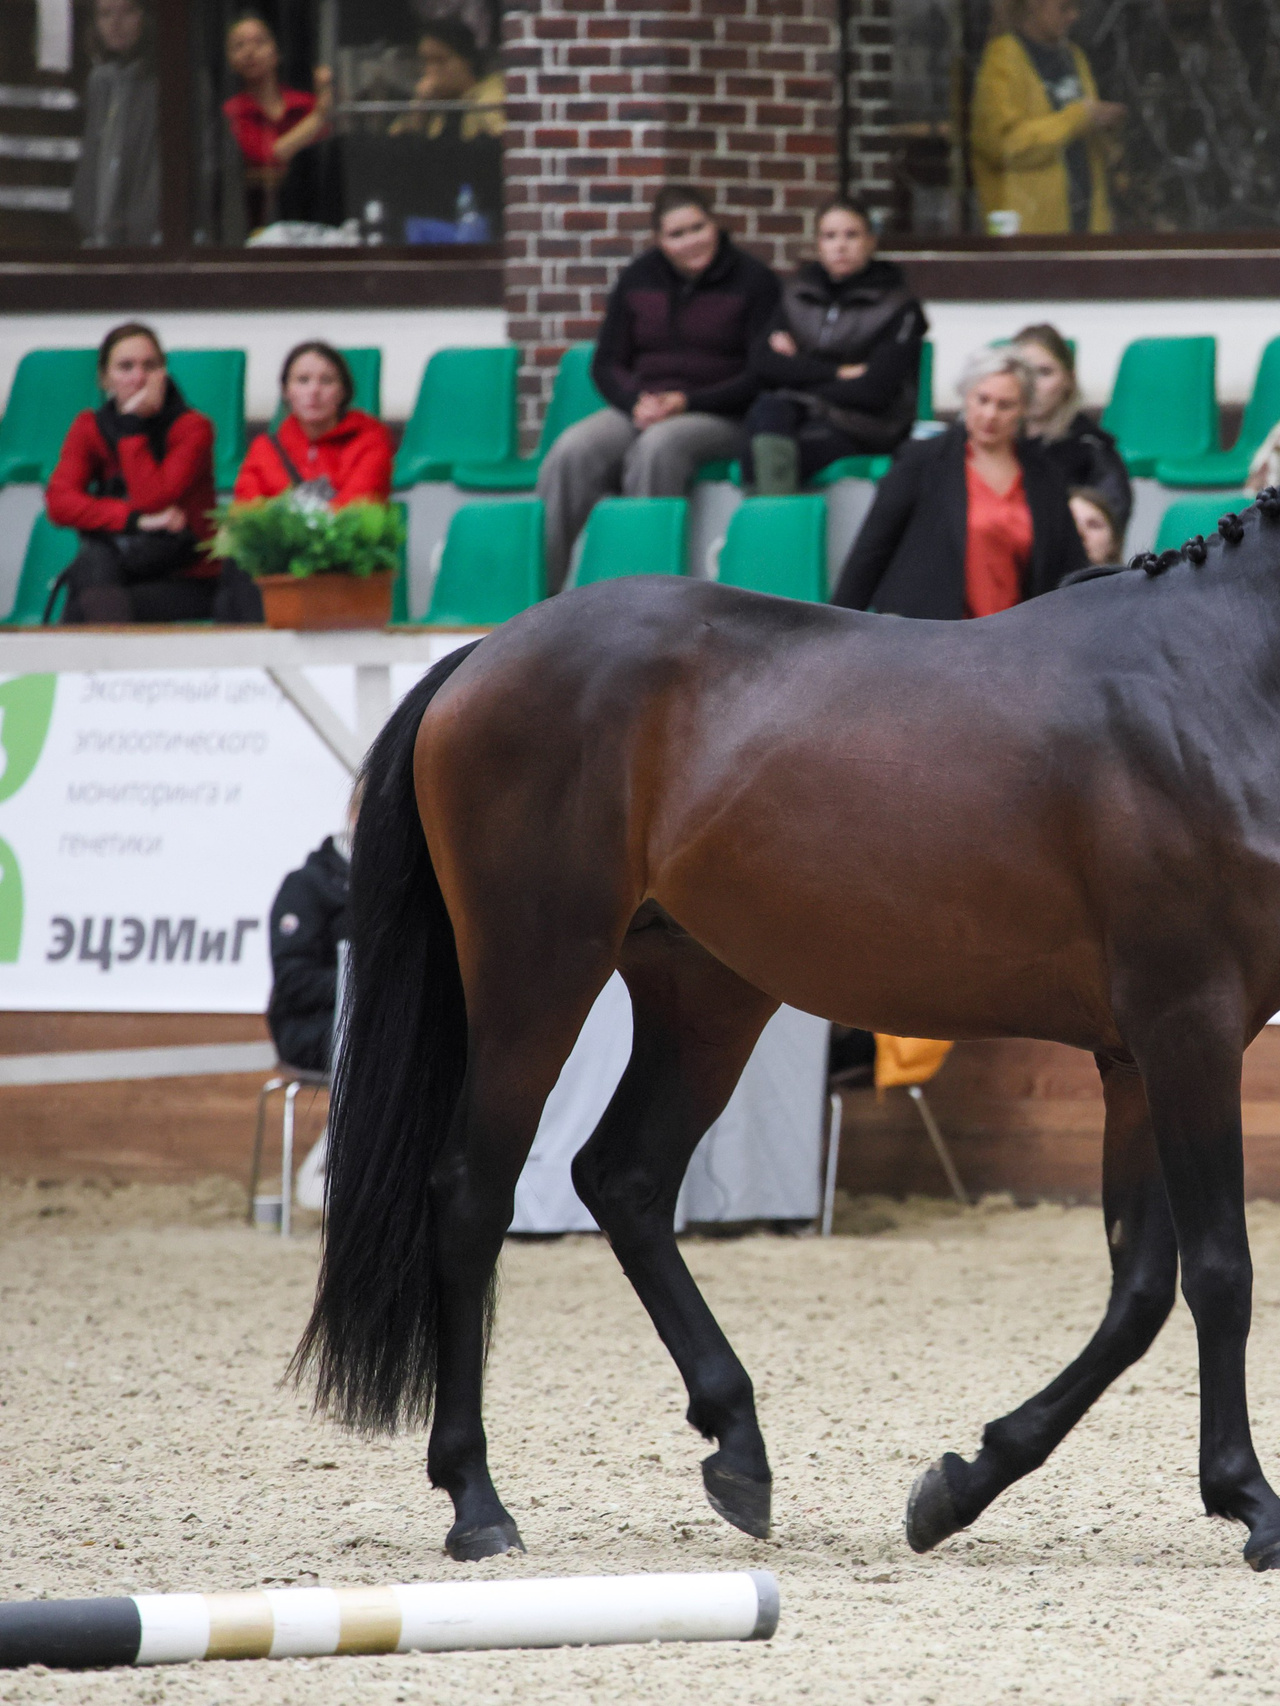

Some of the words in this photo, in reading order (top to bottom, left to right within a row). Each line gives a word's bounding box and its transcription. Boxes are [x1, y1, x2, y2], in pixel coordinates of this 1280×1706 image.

[75, 730, 267, 754] эпизоотического
[67, 782, 219, 810] мониторинга
[226, 782, 241, 804] и
[60, 833, 162, 855] генетики
[47, 916, 259, 971] ЭЦЭМиГ
